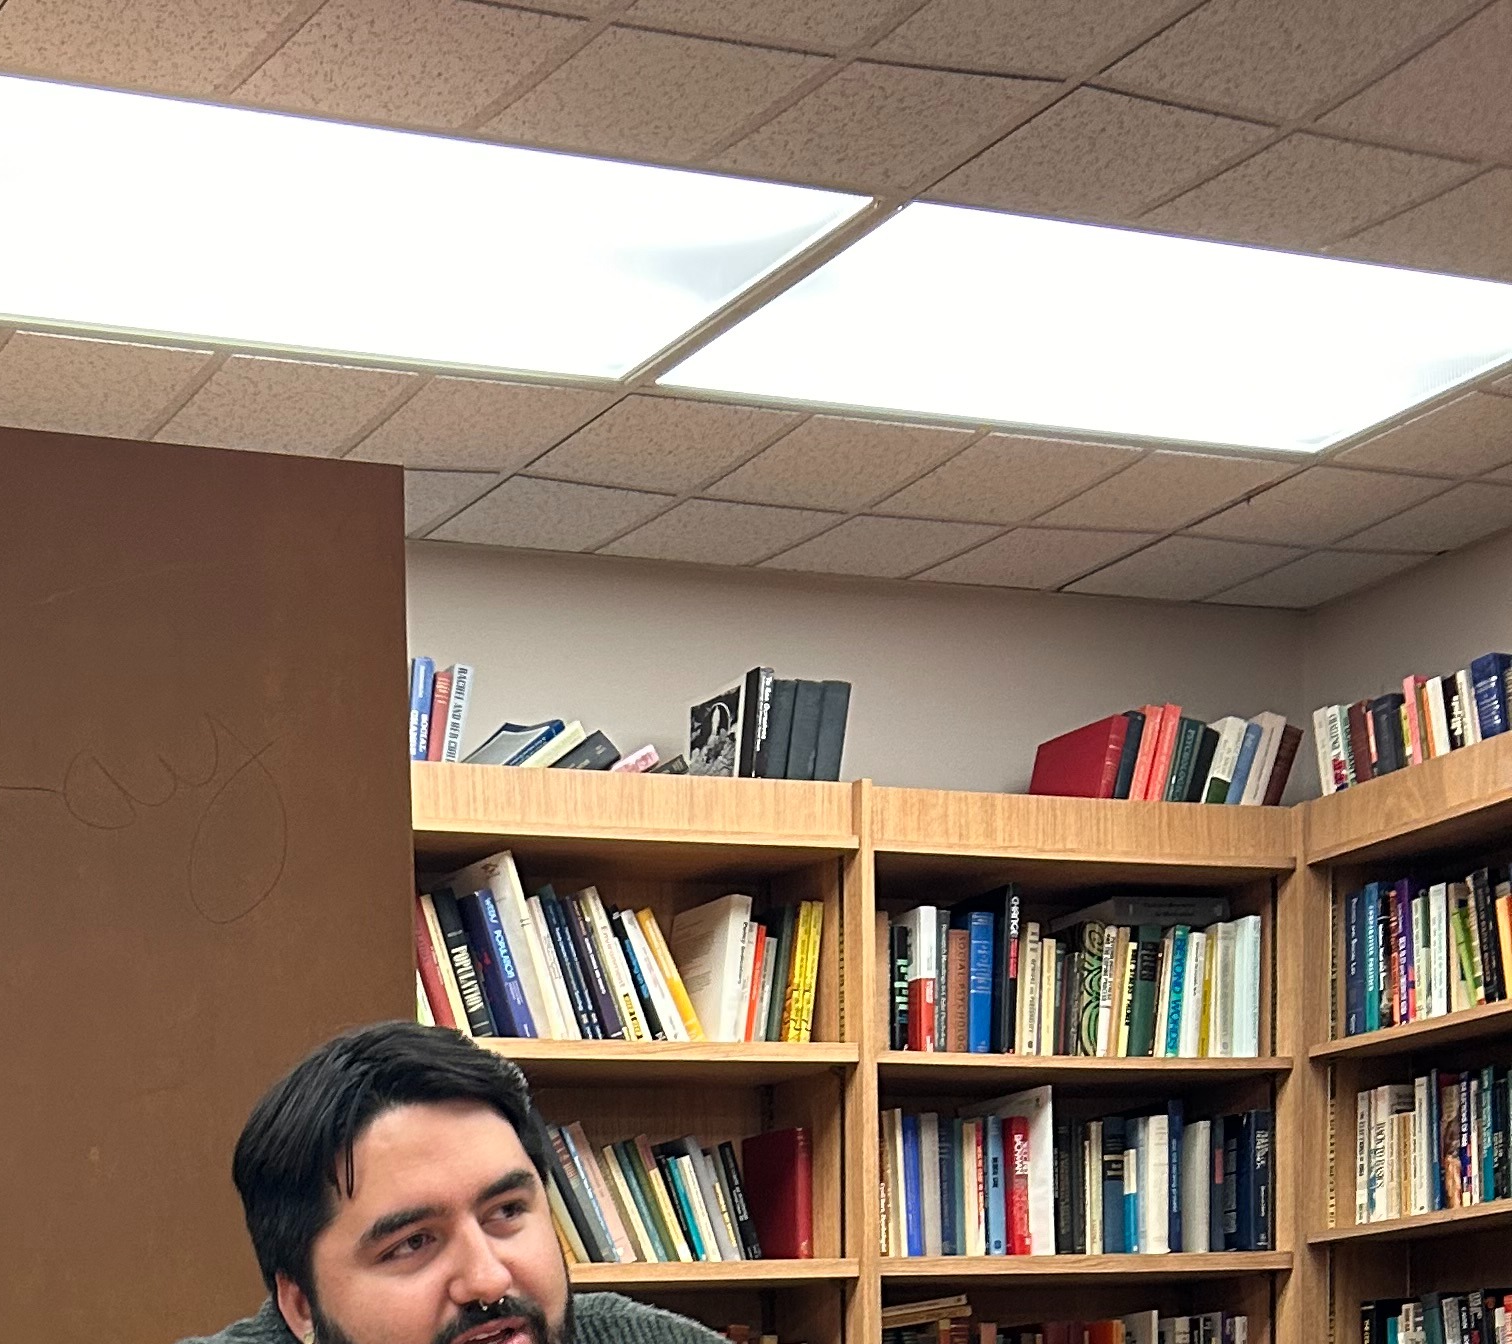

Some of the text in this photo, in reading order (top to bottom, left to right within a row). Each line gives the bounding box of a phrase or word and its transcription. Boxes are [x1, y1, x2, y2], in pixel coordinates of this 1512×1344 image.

[450, 944, 485, 1013] POPULATION
[956, 936, 966, 1050] SOCIAL PSYCHOLOG
[1167, 938, 1187, 1050] BEYOND WORDS
